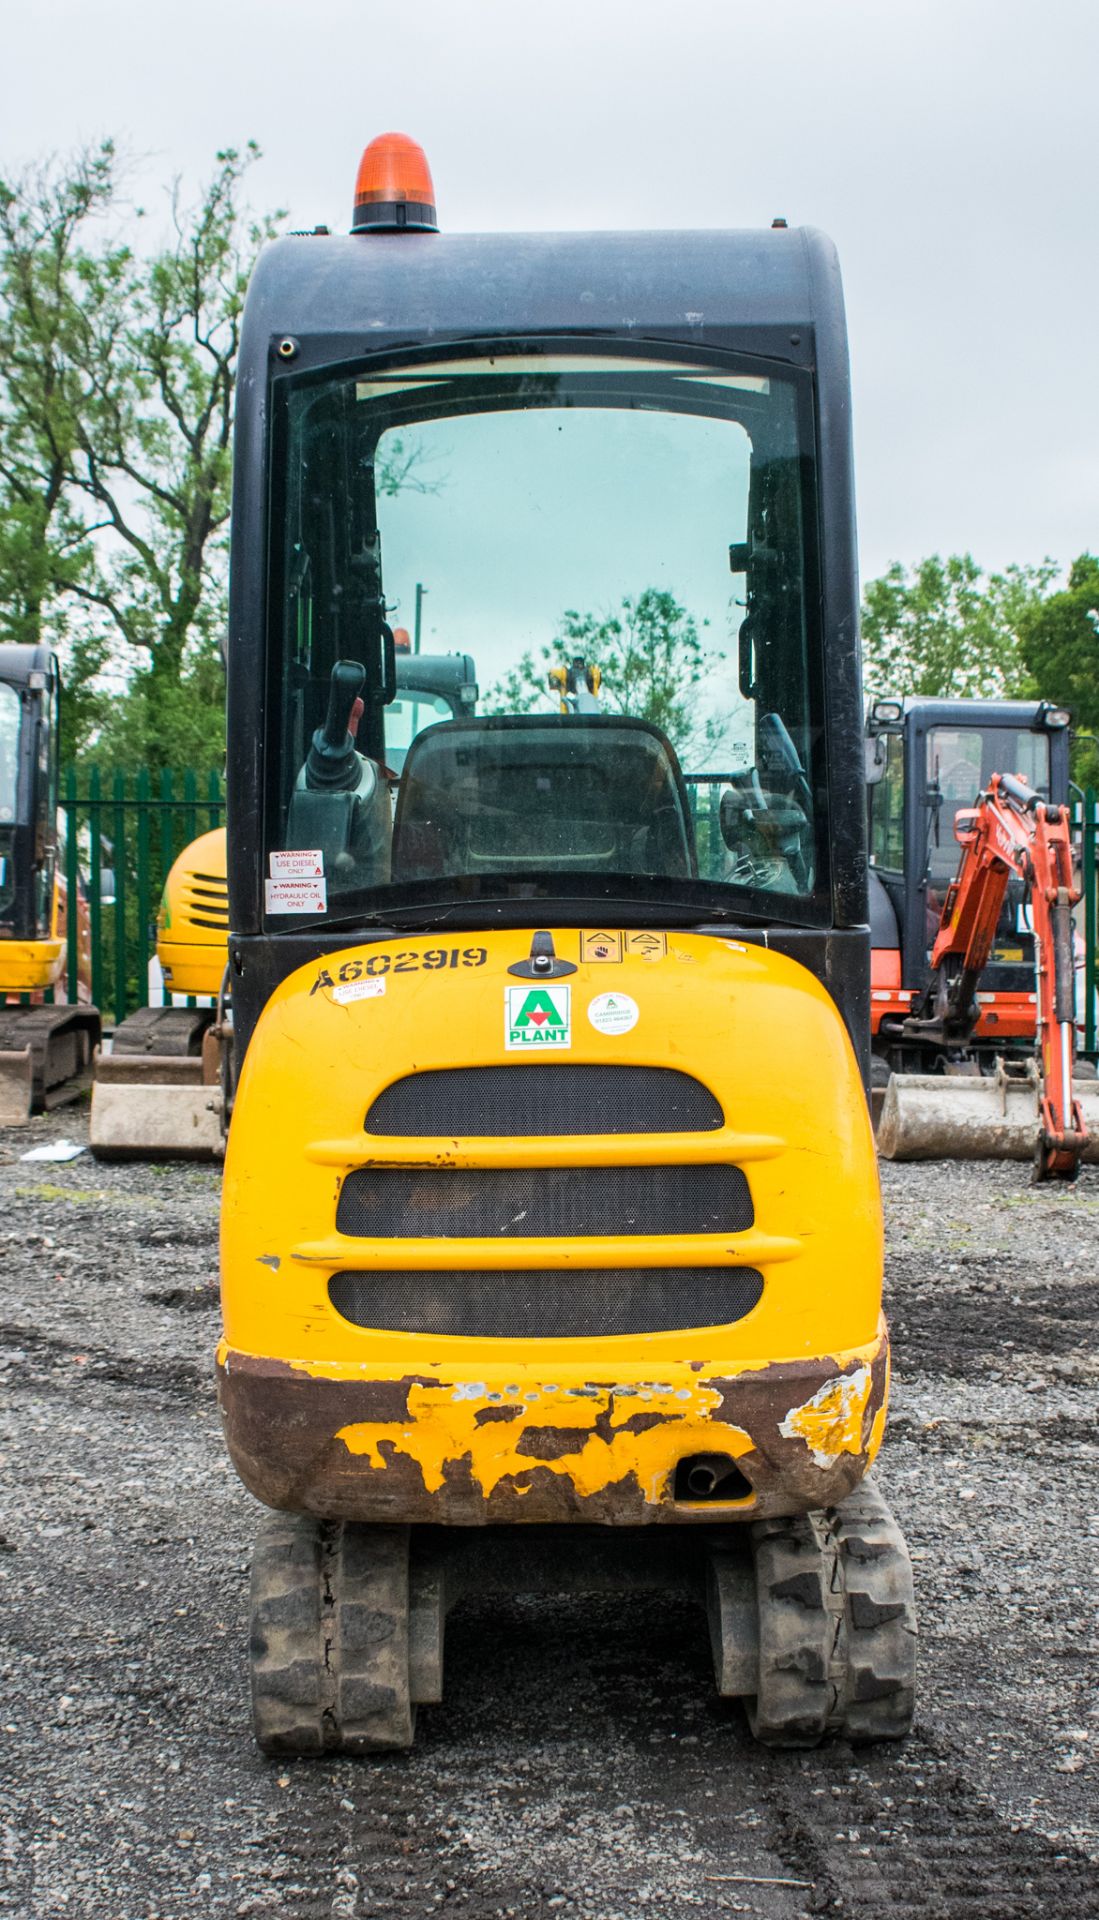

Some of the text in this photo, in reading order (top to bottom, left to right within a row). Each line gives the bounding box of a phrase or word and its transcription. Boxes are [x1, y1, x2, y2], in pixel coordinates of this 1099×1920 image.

[292, 859, 315, 867] DIESEL
[309, 947, 488, 996] A602919
[509, 1029, 569, 1042] PLANT
